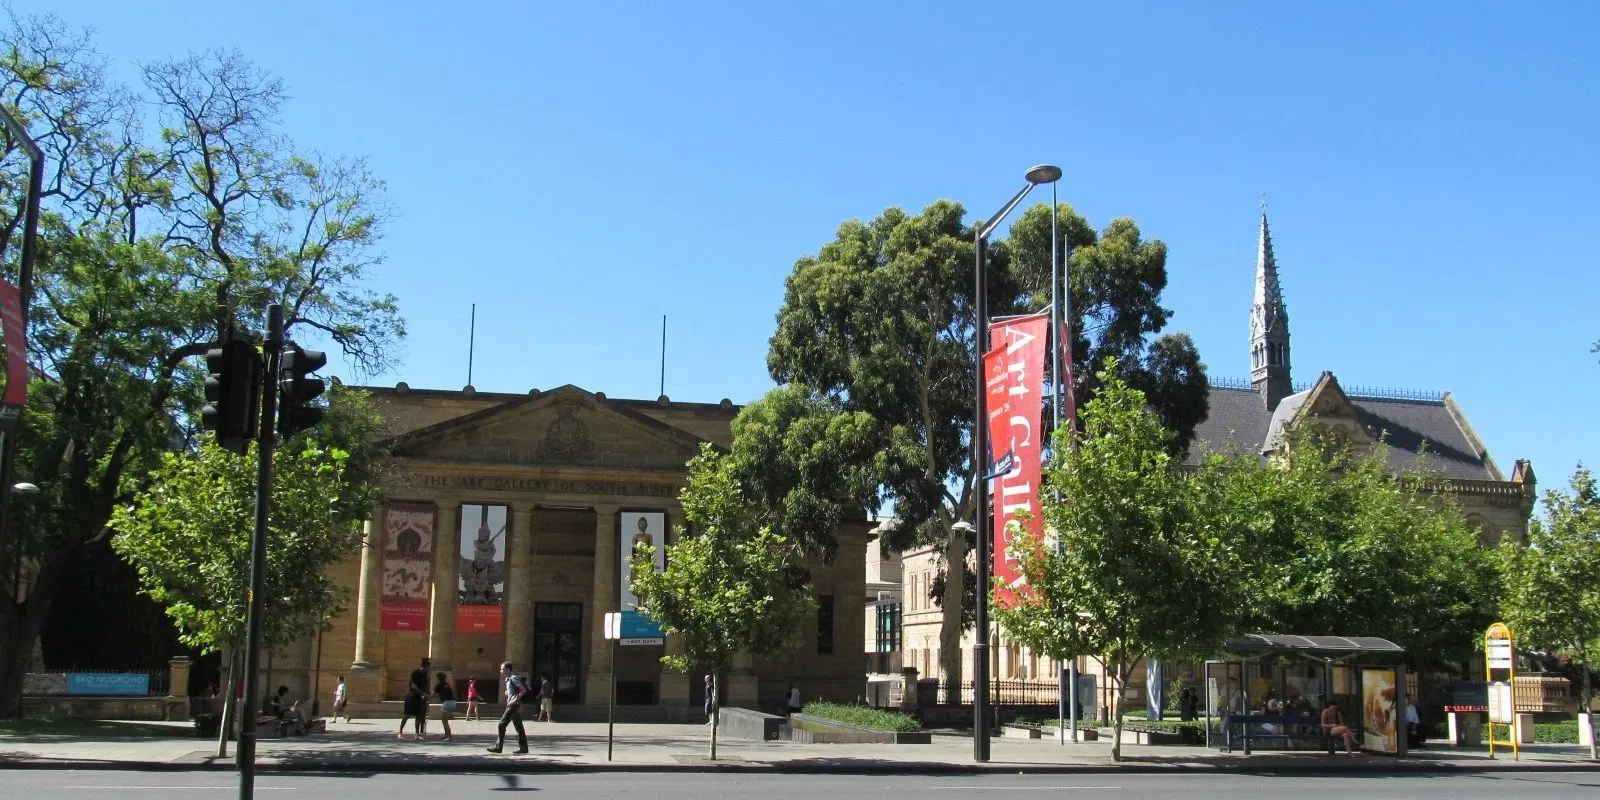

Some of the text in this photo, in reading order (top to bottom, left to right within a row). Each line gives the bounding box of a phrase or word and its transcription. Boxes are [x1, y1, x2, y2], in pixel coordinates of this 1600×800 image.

[1005, 325, 1036, 400] Art
[425, 475, 448, 486] THE
[461, 477, 483, 487] ART
[495, 478, 550, 489] GALLERY
[560, 481, 576, 490] OF
